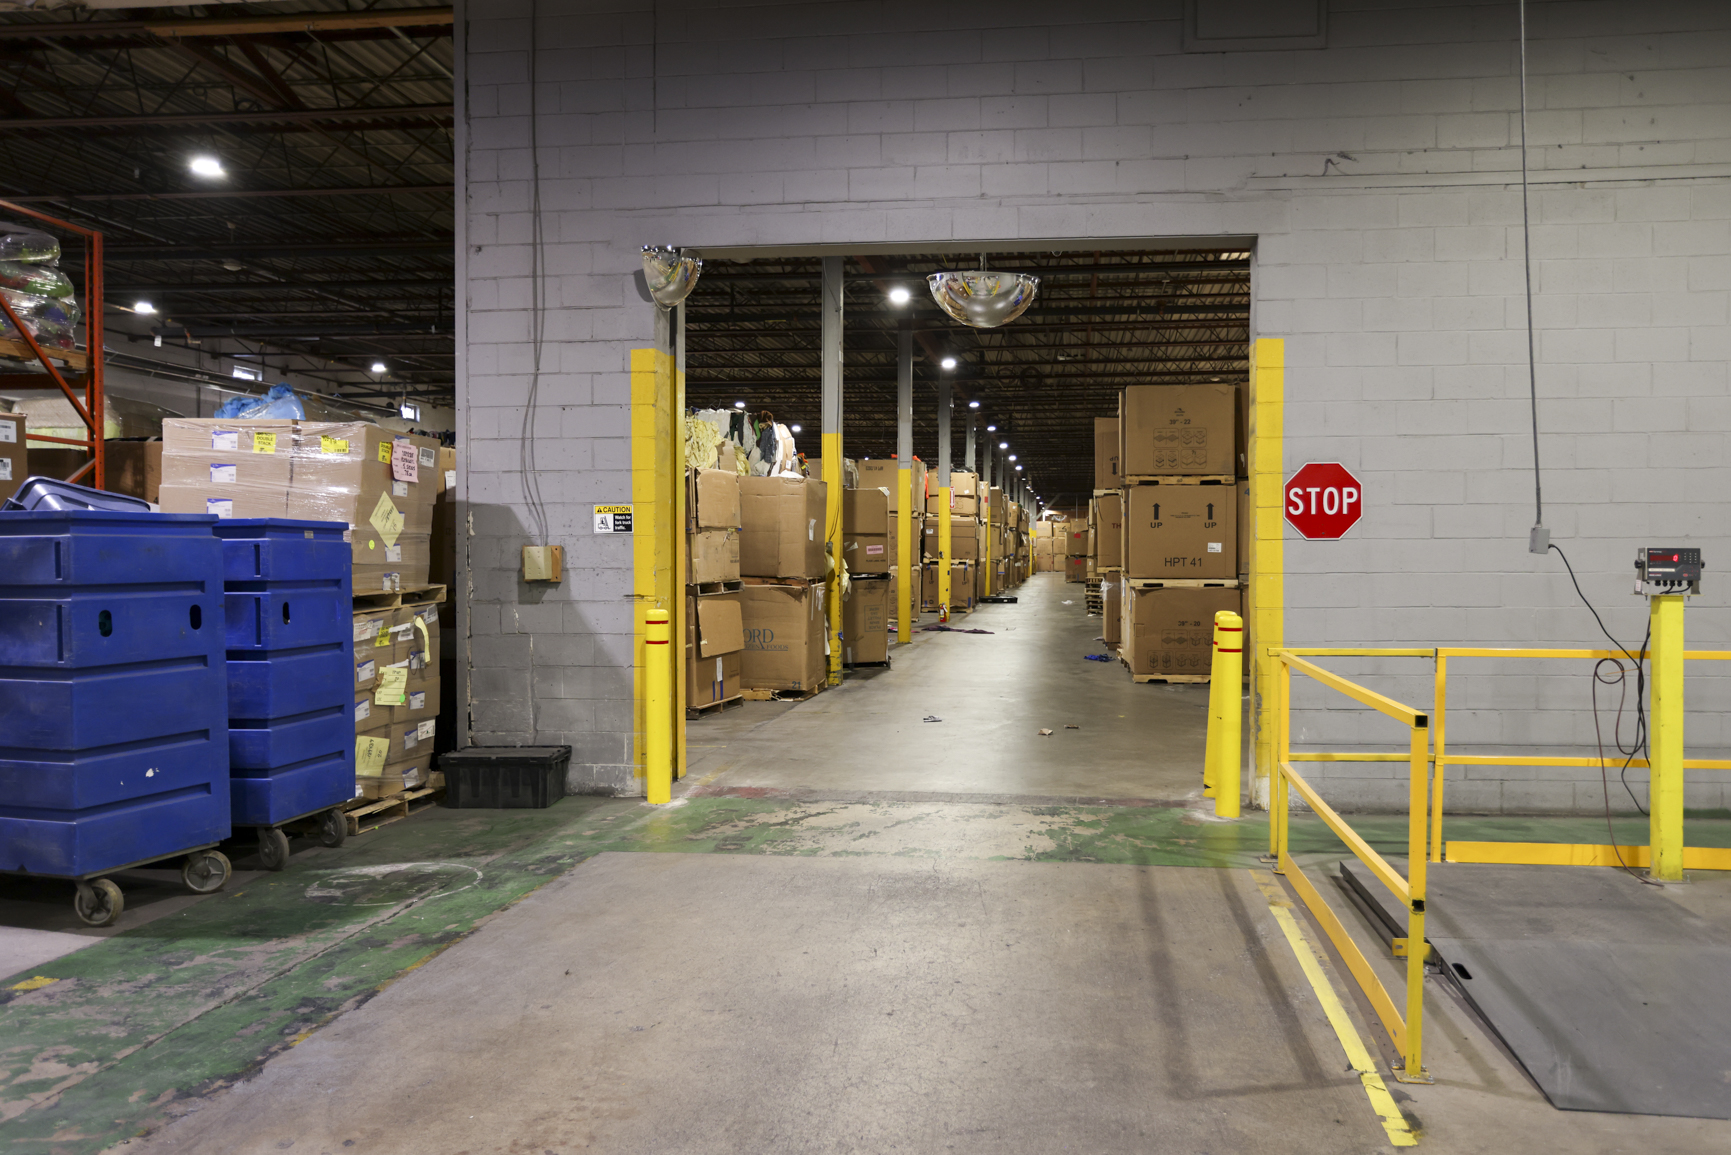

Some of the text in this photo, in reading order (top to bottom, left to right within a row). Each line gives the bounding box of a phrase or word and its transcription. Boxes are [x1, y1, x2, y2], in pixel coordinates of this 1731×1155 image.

[1288, 486, 1358, 515] STOP
[1164, 557, 1202, 567] HPT 41
[1672, 553, 1679, 562] 0
[791, 680, 801, 689] 21
